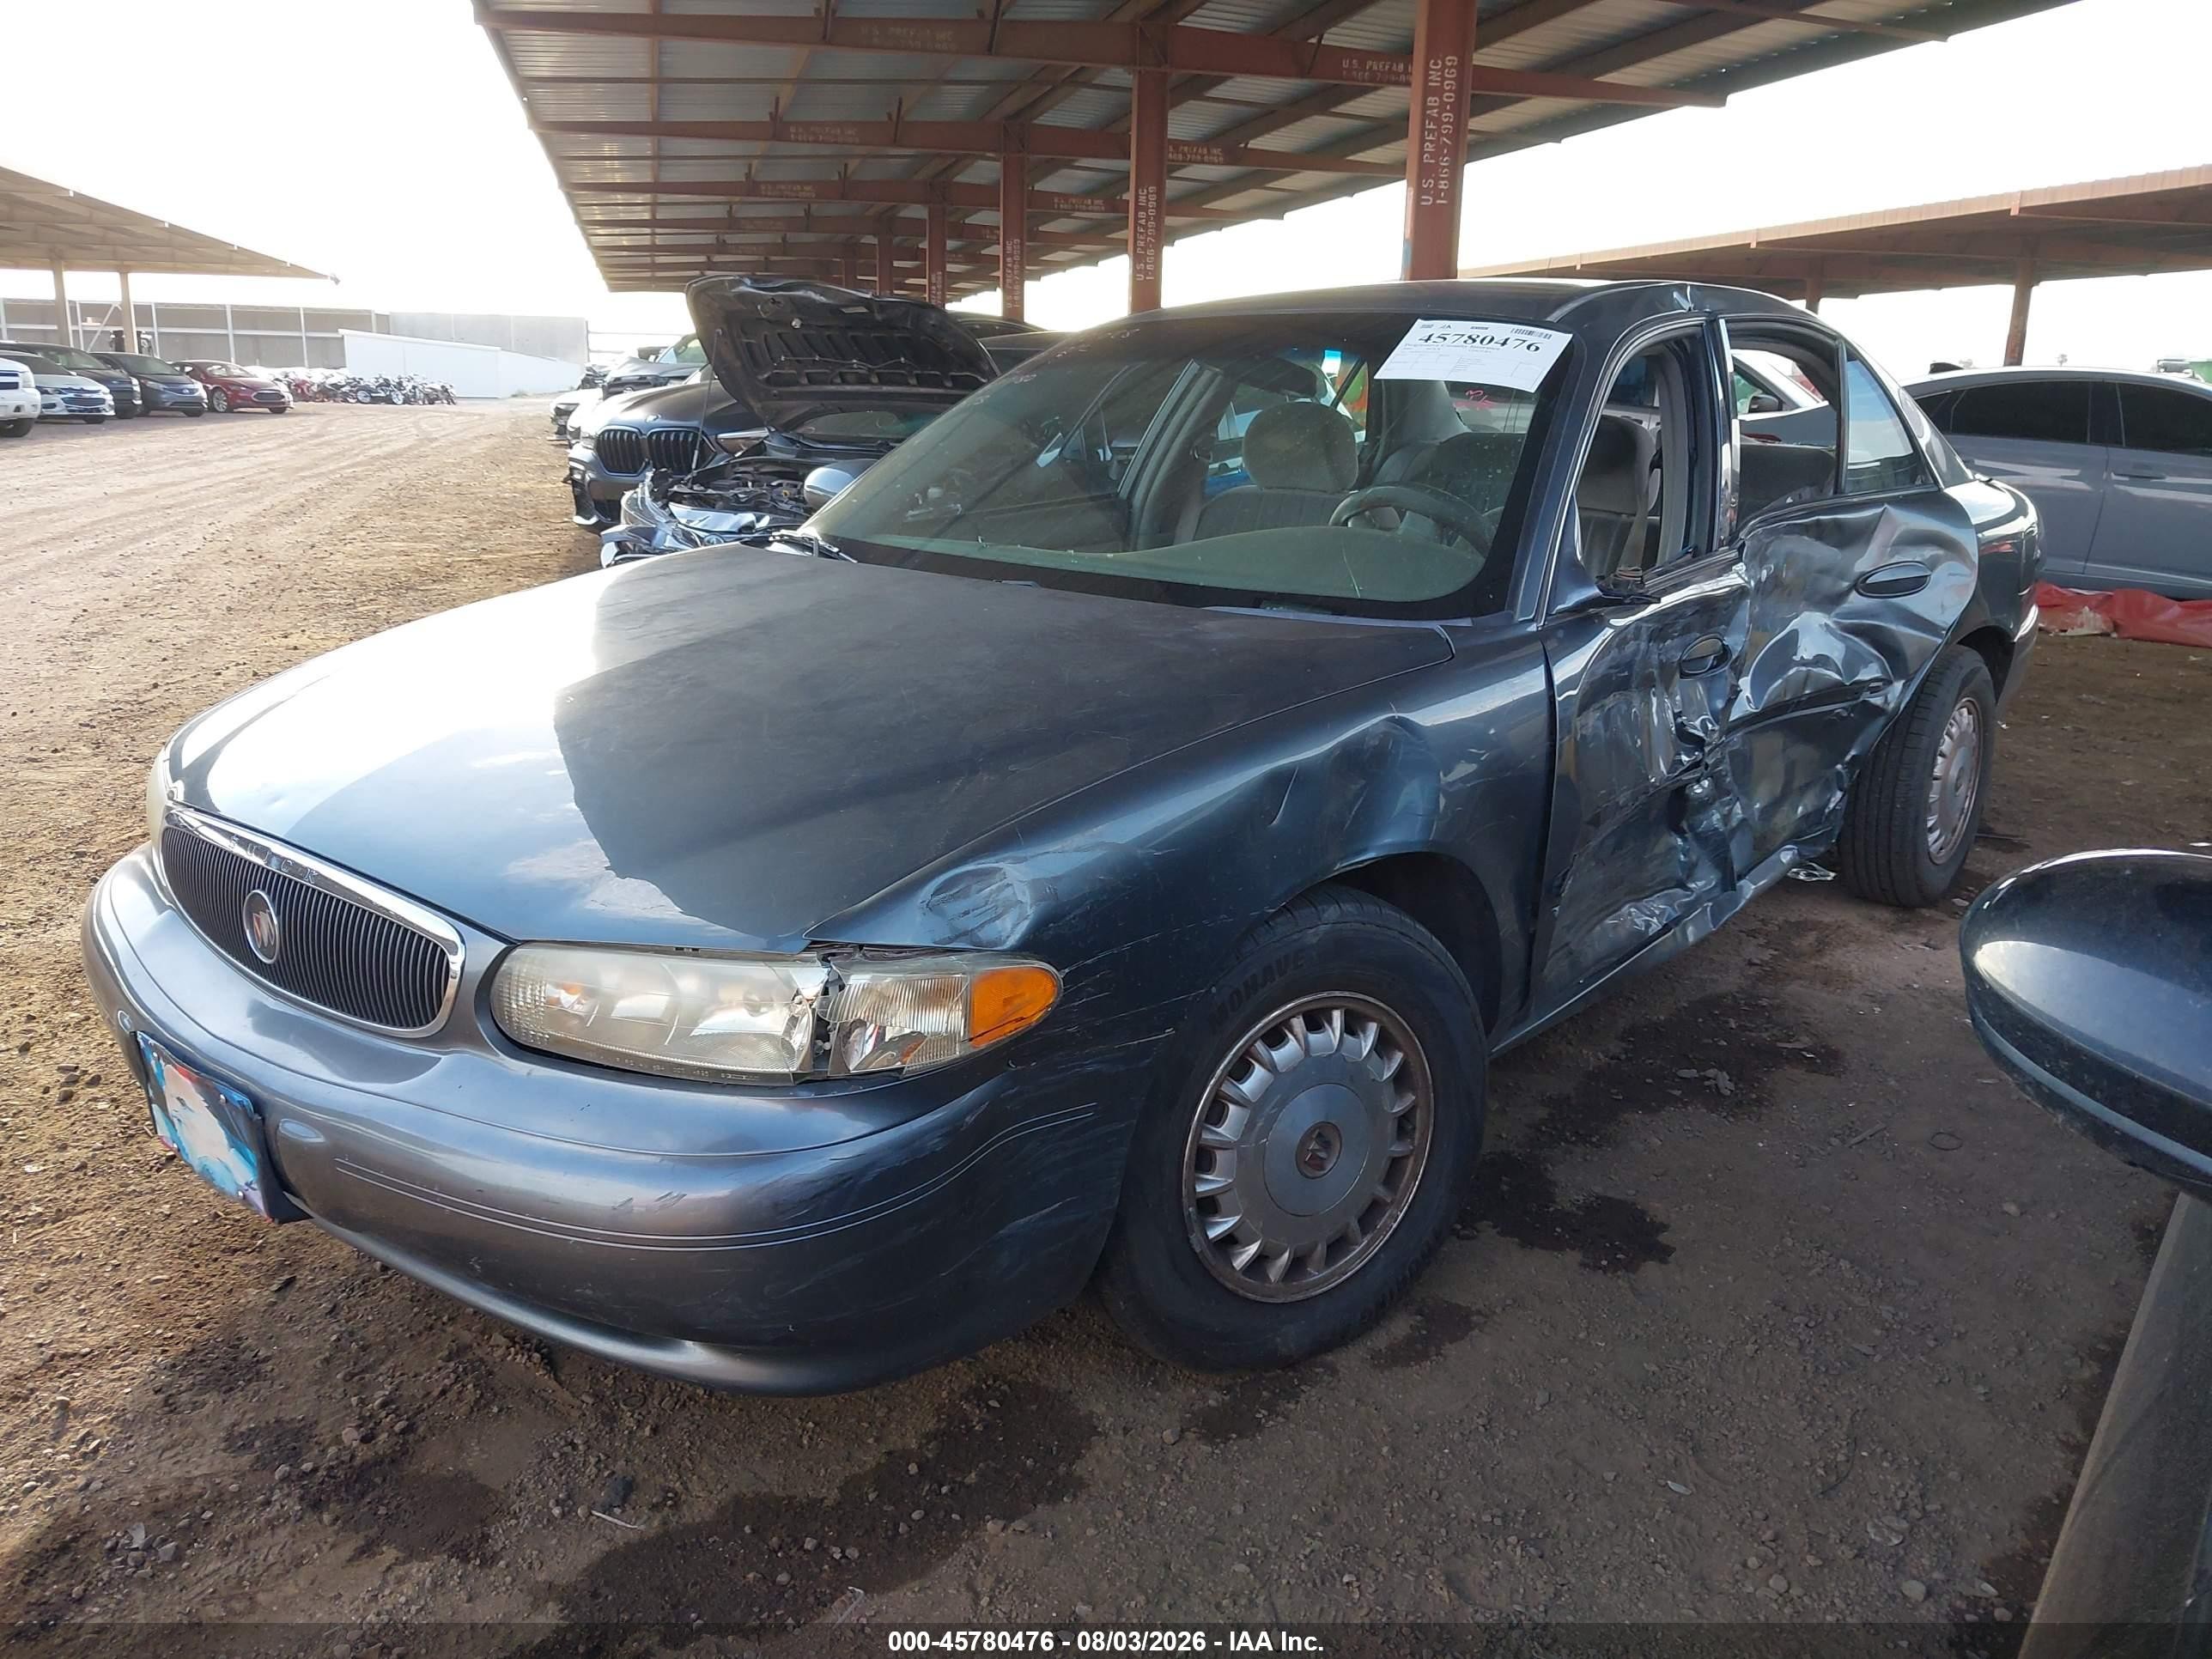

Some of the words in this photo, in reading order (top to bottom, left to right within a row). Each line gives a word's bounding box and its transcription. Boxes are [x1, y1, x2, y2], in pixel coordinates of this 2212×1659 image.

[1423, 96, 1440, 163] PREFAB
[1436, 56, 1459, 204] 1-866-799-0969
[1419, 173, 1435, 206] U.S.
[1136, 211, 1147, 254] PREFAB
[1419, 332, 1544, 353] 45780476
